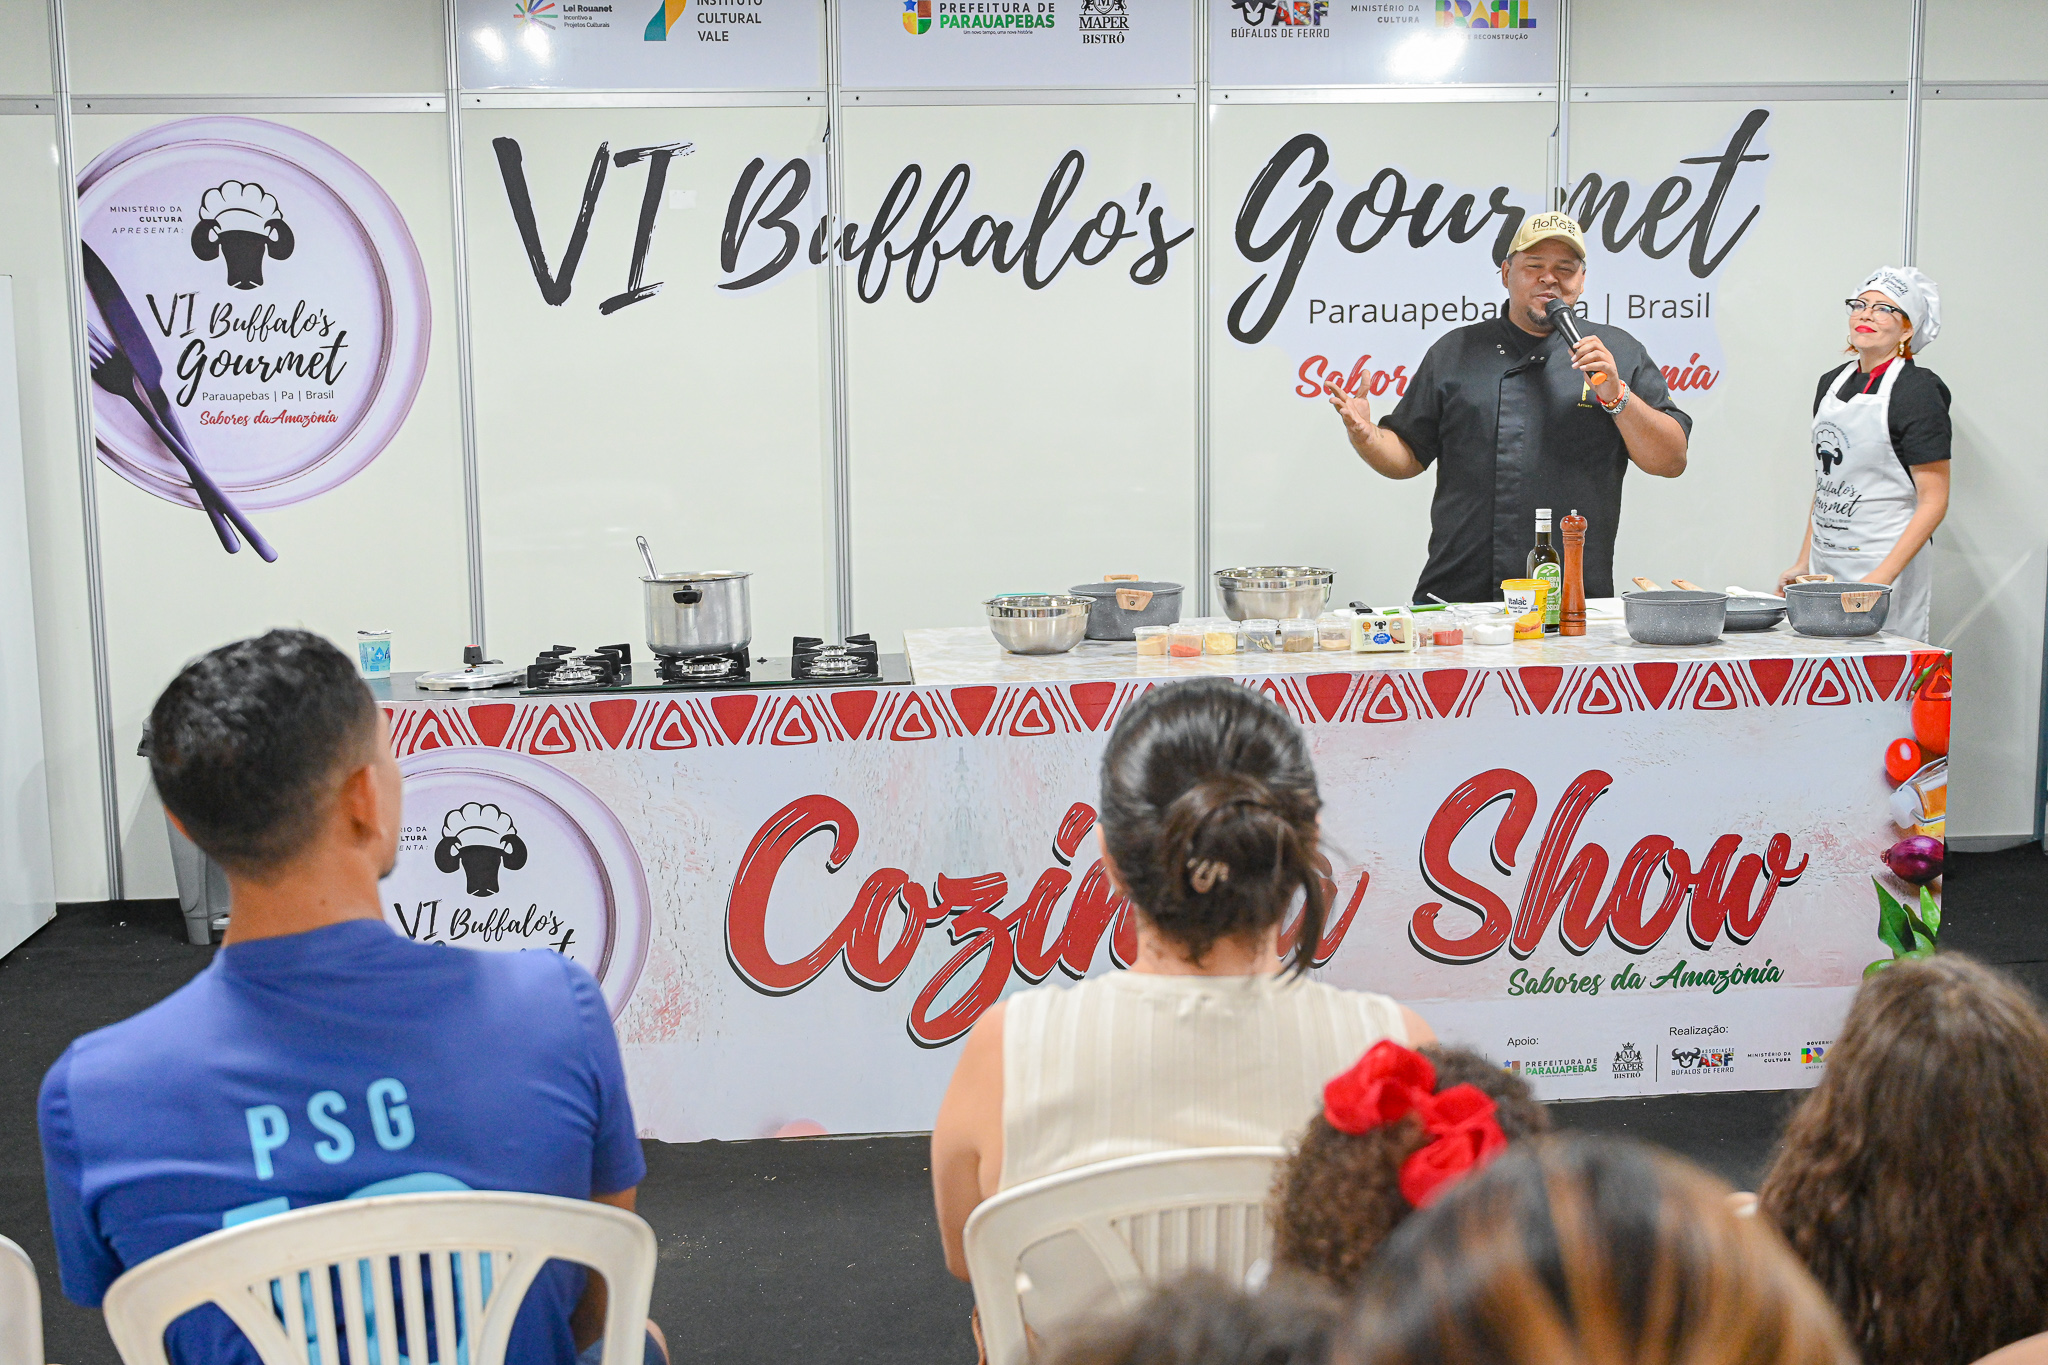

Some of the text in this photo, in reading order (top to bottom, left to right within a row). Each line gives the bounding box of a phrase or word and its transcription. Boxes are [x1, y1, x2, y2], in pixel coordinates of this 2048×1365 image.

[563, 4, 613, 13] Lei Rouanet
[939, 2, 1055, 13] PREFEITURA DE
[1271, 0, 1330, 27] ABF
[1350, 3, 1420, 12] MINISTÉRIO DA
[697, 12, 762, 24] CULTURAL
[1377, 16, 1420, 24] CULTURA
[1435, 0, 1537, 29] BRASIL
[939, 14, 1056, 29] PARAUAPEBAS
[1078, 16, 1130, 29] MAPER
[697, 30, 729, 42] VALE
[1082, 31, 1125, 44] BISTRÔ
[1231, 26, 1330, 38] BÚFALOS DE FERRO
[1473, 32, 1529, 41] RECONSTRUÇÃO
[109, 204, 166, 213] MINISTÉRIO
[493, 135, 1195, 316] VI Buffalo's
[1226, 108, 1771, 345] Gourmet
[145, 290, 336, 342] VI Buffalo's
[1309, 295, 1498, 330] Parauapeba
[1627, 291, 1711, 320] Brasil
[175, 330, 349, 408] Gourmet
[1295, 353, 1415, 399] Sabor
[202, 389, 334, 403] Parauapebas Pa Brasil
[199, 410, 251, 426] Sabores
[1407, 768, 1809, 966] Show
[393, 898, 565, 943] VI Buffalo's
[1507, 957, 1785, 997] Sabores da Amazônia
[1669, 1024, 1730, 1037] Realização:
[1506, 1036, 1539, 1048] Apoio:
[1696, 1052, 1735, 1069] ABF
[1747, 1050, 1782, 1058] MINISTÉRIO
[1525, 1057, 1598, 1067] PREFEITURA DE
[1612, 1062, 1644, 1072] MAPER
[1525, 1063, 1598, 1076] PARAUAPEBAS
[1613, 1071, 1642, 1080] BISTRÔ
[1671, 1066, 1735, 1076] BÚFALOS DE FERRO
